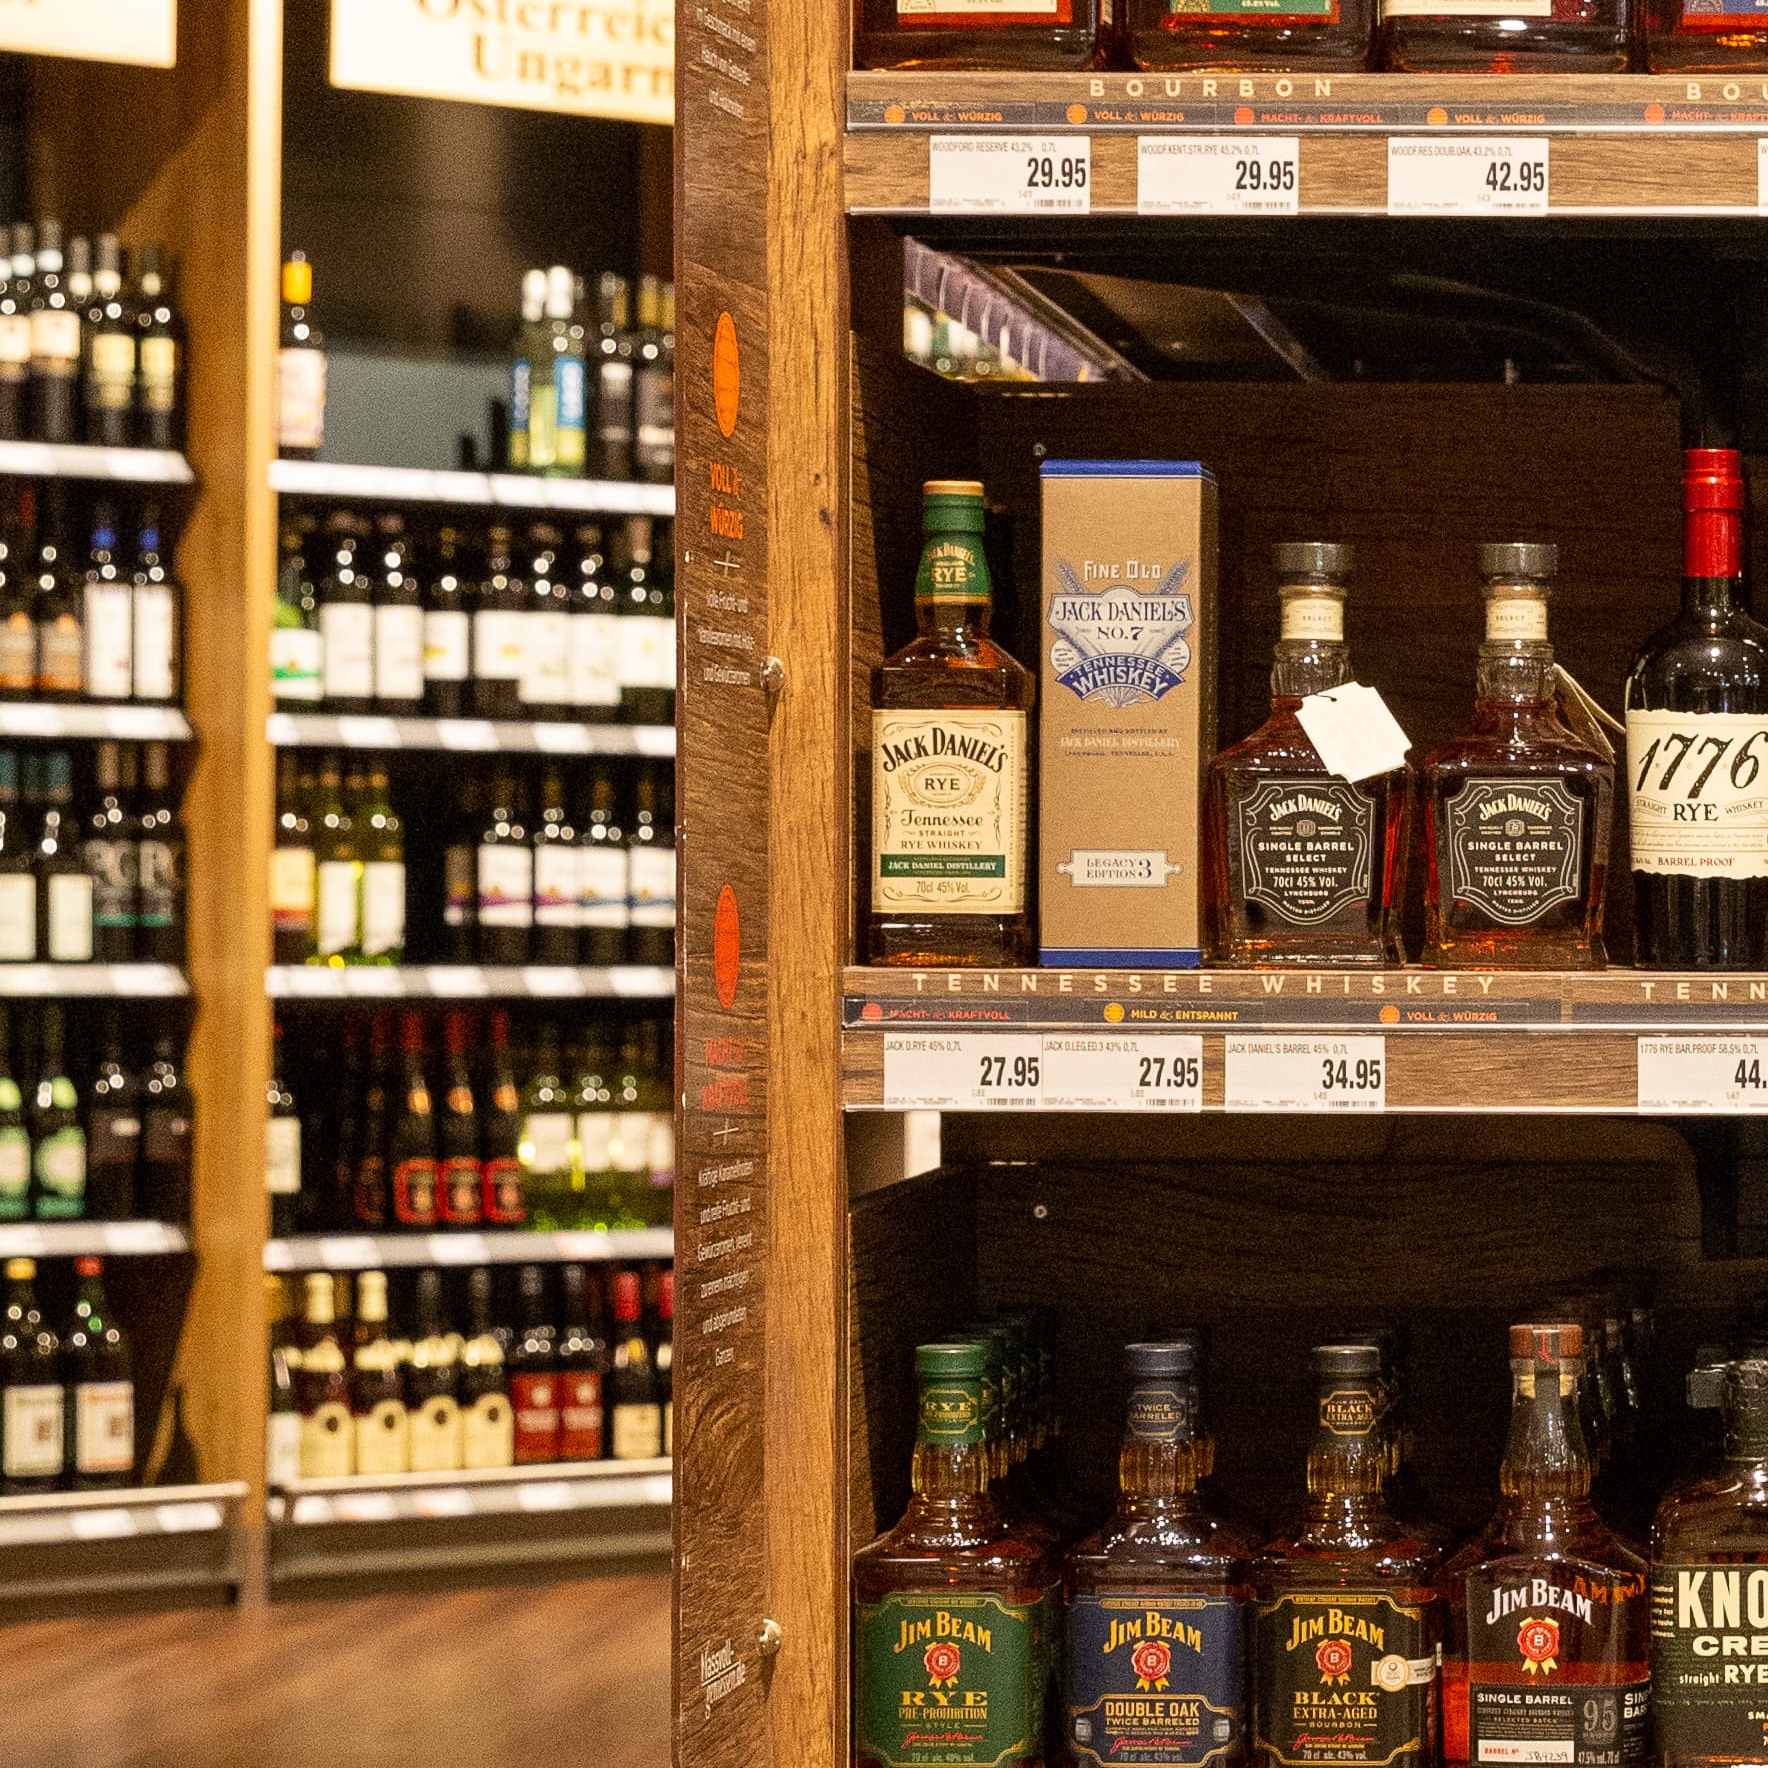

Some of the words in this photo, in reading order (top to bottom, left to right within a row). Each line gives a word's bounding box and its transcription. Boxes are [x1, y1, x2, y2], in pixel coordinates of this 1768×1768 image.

[1090, 79, 1331, 97] BOURBON
[1094, 111, 1122, 122] VOLL
[1140, 110, 1184, 122] WÜRZIG
[1028, 158, 1086, 188] 29.95
[1235, 160, 1294, 190] 29.95
[1485, 161, 1544, 191] 42.95
[1084, 560, 1121, 581] FINE
[1053, 601, 1103, 621] JACK
[1108, 600, 1188, 622] DANIEL'S
[1074, 655, 1167, 684] TENNESSEE
[1071, 667, 1169, 700] WHISKEY
[882, 736, 926, 773] JACK
[932, 727, 1008, 773] DANIEL'S
[924, 778, 960, 791] RYE
[1478, 802, 1506, 822] JACK
[1507, 794, 1552, 822] DANIEL'S
[1674, 803, 1718, 822] RYE
[901, 809, 983, 827] Tennessee
[901, 840, 924, 849] RYE
[927, 840, 983, 849] WHISKEY
[1467, 841, 1510, 851] SINGLE
[1516, 841, 1564, 851] BARREL
[1087, 858, 1134, 868] LEGACY
[1496, 853, 1537, 863] SELECT
[1087, 869, 1136, 879] EDITION
[913, 975, 1212, 992] TENNESSEE
[1261, 977, 1494, 993] WHISKEY
[1131, 1009, 1156, 1020] MILD
[1176, 1009, 1238, 1022] ENTSPANNT
[1228, 1044, 1247, 1054] JACK
[1283, 1043, 1312, 1054] BARREL
[980, 1056, 1040, 1087] 27.95
[1139, 1057, 1199, 1088] 27.95
[1322, 1059, 1381, 1089] 34.95
[1486, 1587, 1528, 1625] JIM
[1531, 1579, 1593, 1624] BEAM
[894, 1620, 931, 1654] JIM
[936, 1612, 991, 1652] BEAM
[1724, 1665, 1768, 1684] RYE
[902, 1691, 988, 1706] RYE
[1295, 1692, 1375, 1706] BLACK
[1477, 1694, 1521, 1704] SINGLE
[1526, 1696, 1573, 1705] BARREL
[1106, 1702, 1167, 1717] DOUBLE
[1171, 1702, 1199, 1717] OAK
[1293, 1707, 1378, 1720] EXTRA-AGED
